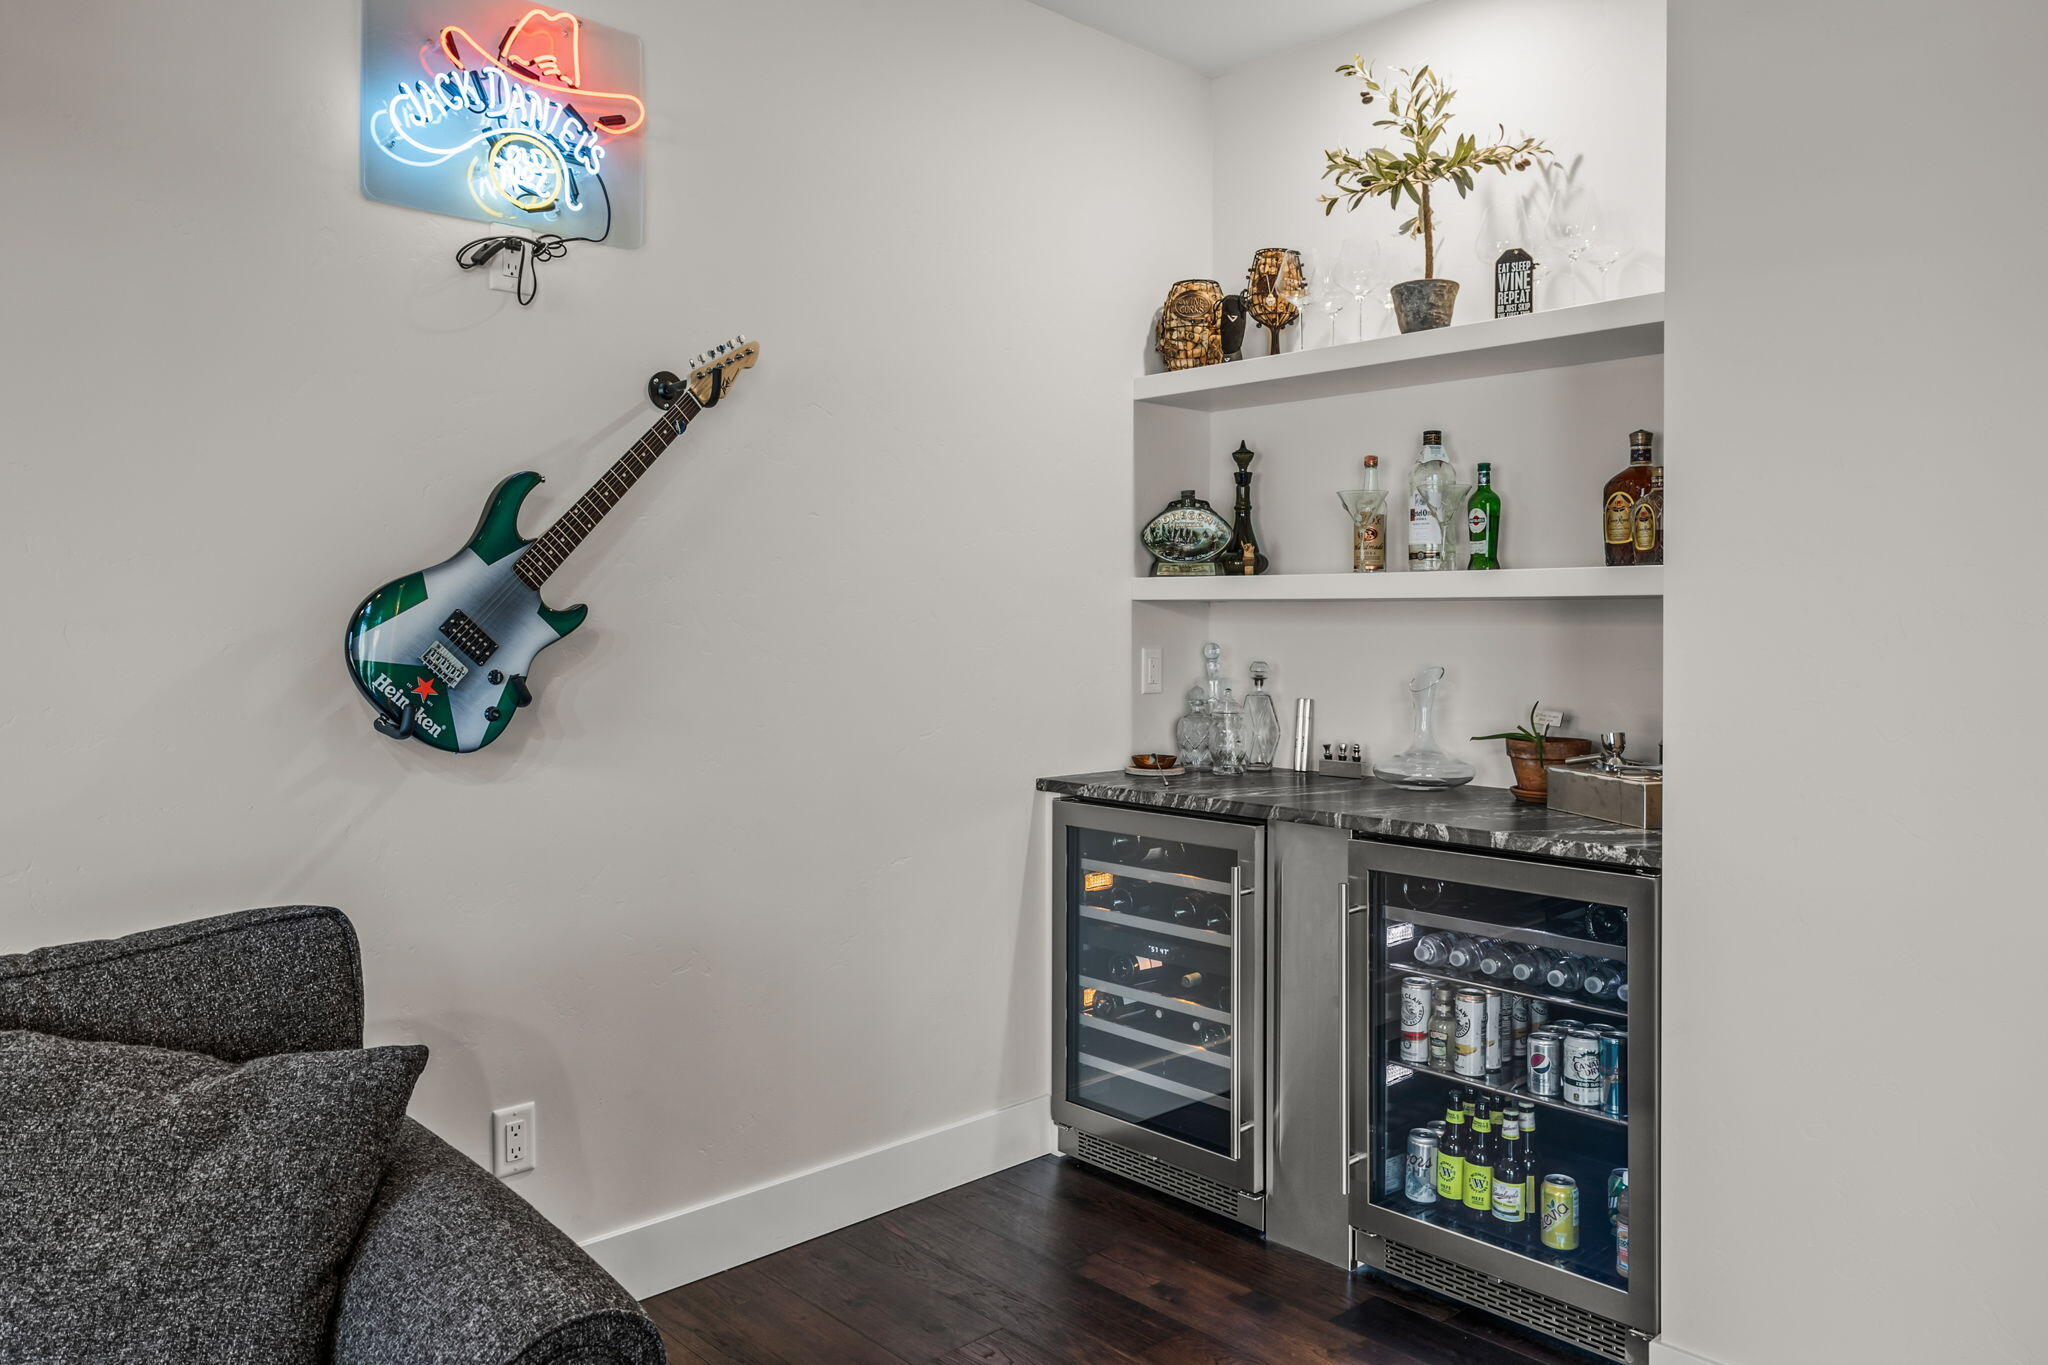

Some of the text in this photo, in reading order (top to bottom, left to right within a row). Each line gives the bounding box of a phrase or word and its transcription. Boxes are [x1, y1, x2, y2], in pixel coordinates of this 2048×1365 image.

[390, 66, 606, 175] JACK DANIEL'S
[1498, 260, 1531, 274] EAT SLEEP
[1498, 270, 1531, 291] WINE
[1497, 289, 1531, 305] REPEAT
[372, 672, 442, 738] Heinken
